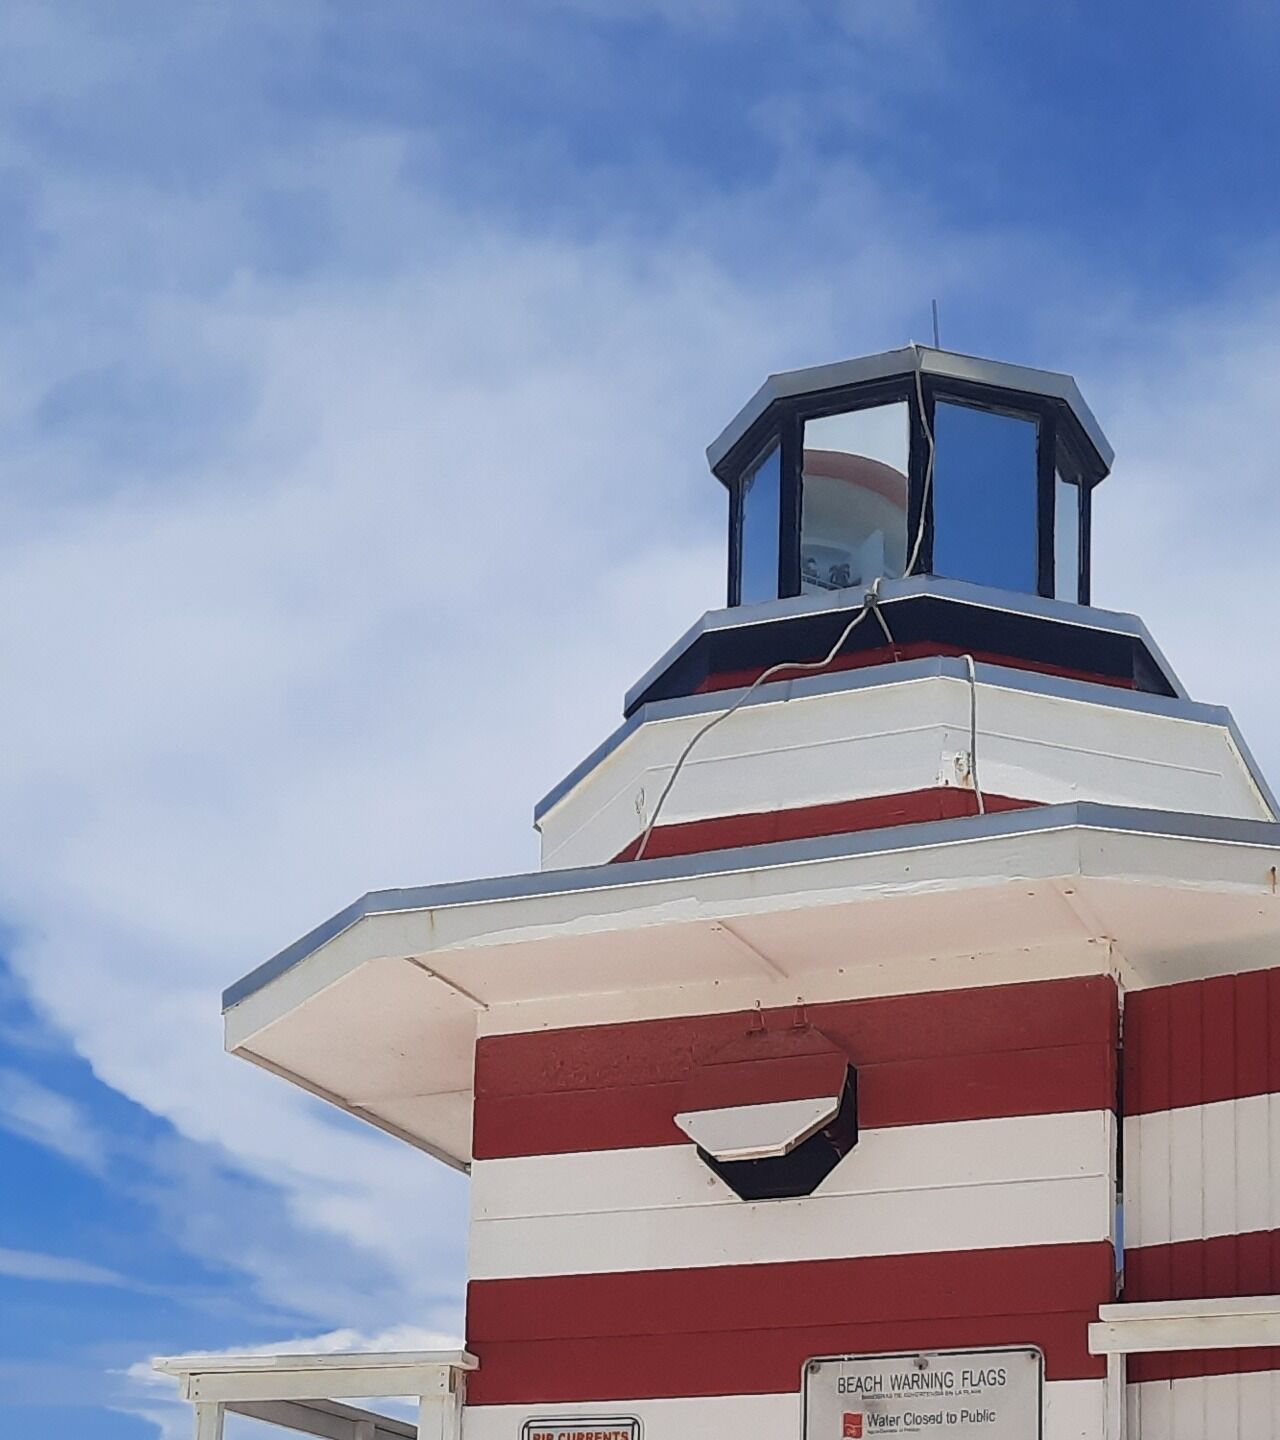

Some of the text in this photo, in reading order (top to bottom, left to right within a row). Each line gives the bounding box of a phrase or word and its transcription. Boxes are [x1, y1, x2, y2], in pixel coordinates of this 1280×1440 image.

[837, 1375, 883, 1394] BEACH
[890, 1371, 954, 1390] WARNING
[961, 1368, 1006, 1387] FLAGS
[867, 1408, 996, 1427] Water Closed to Public
